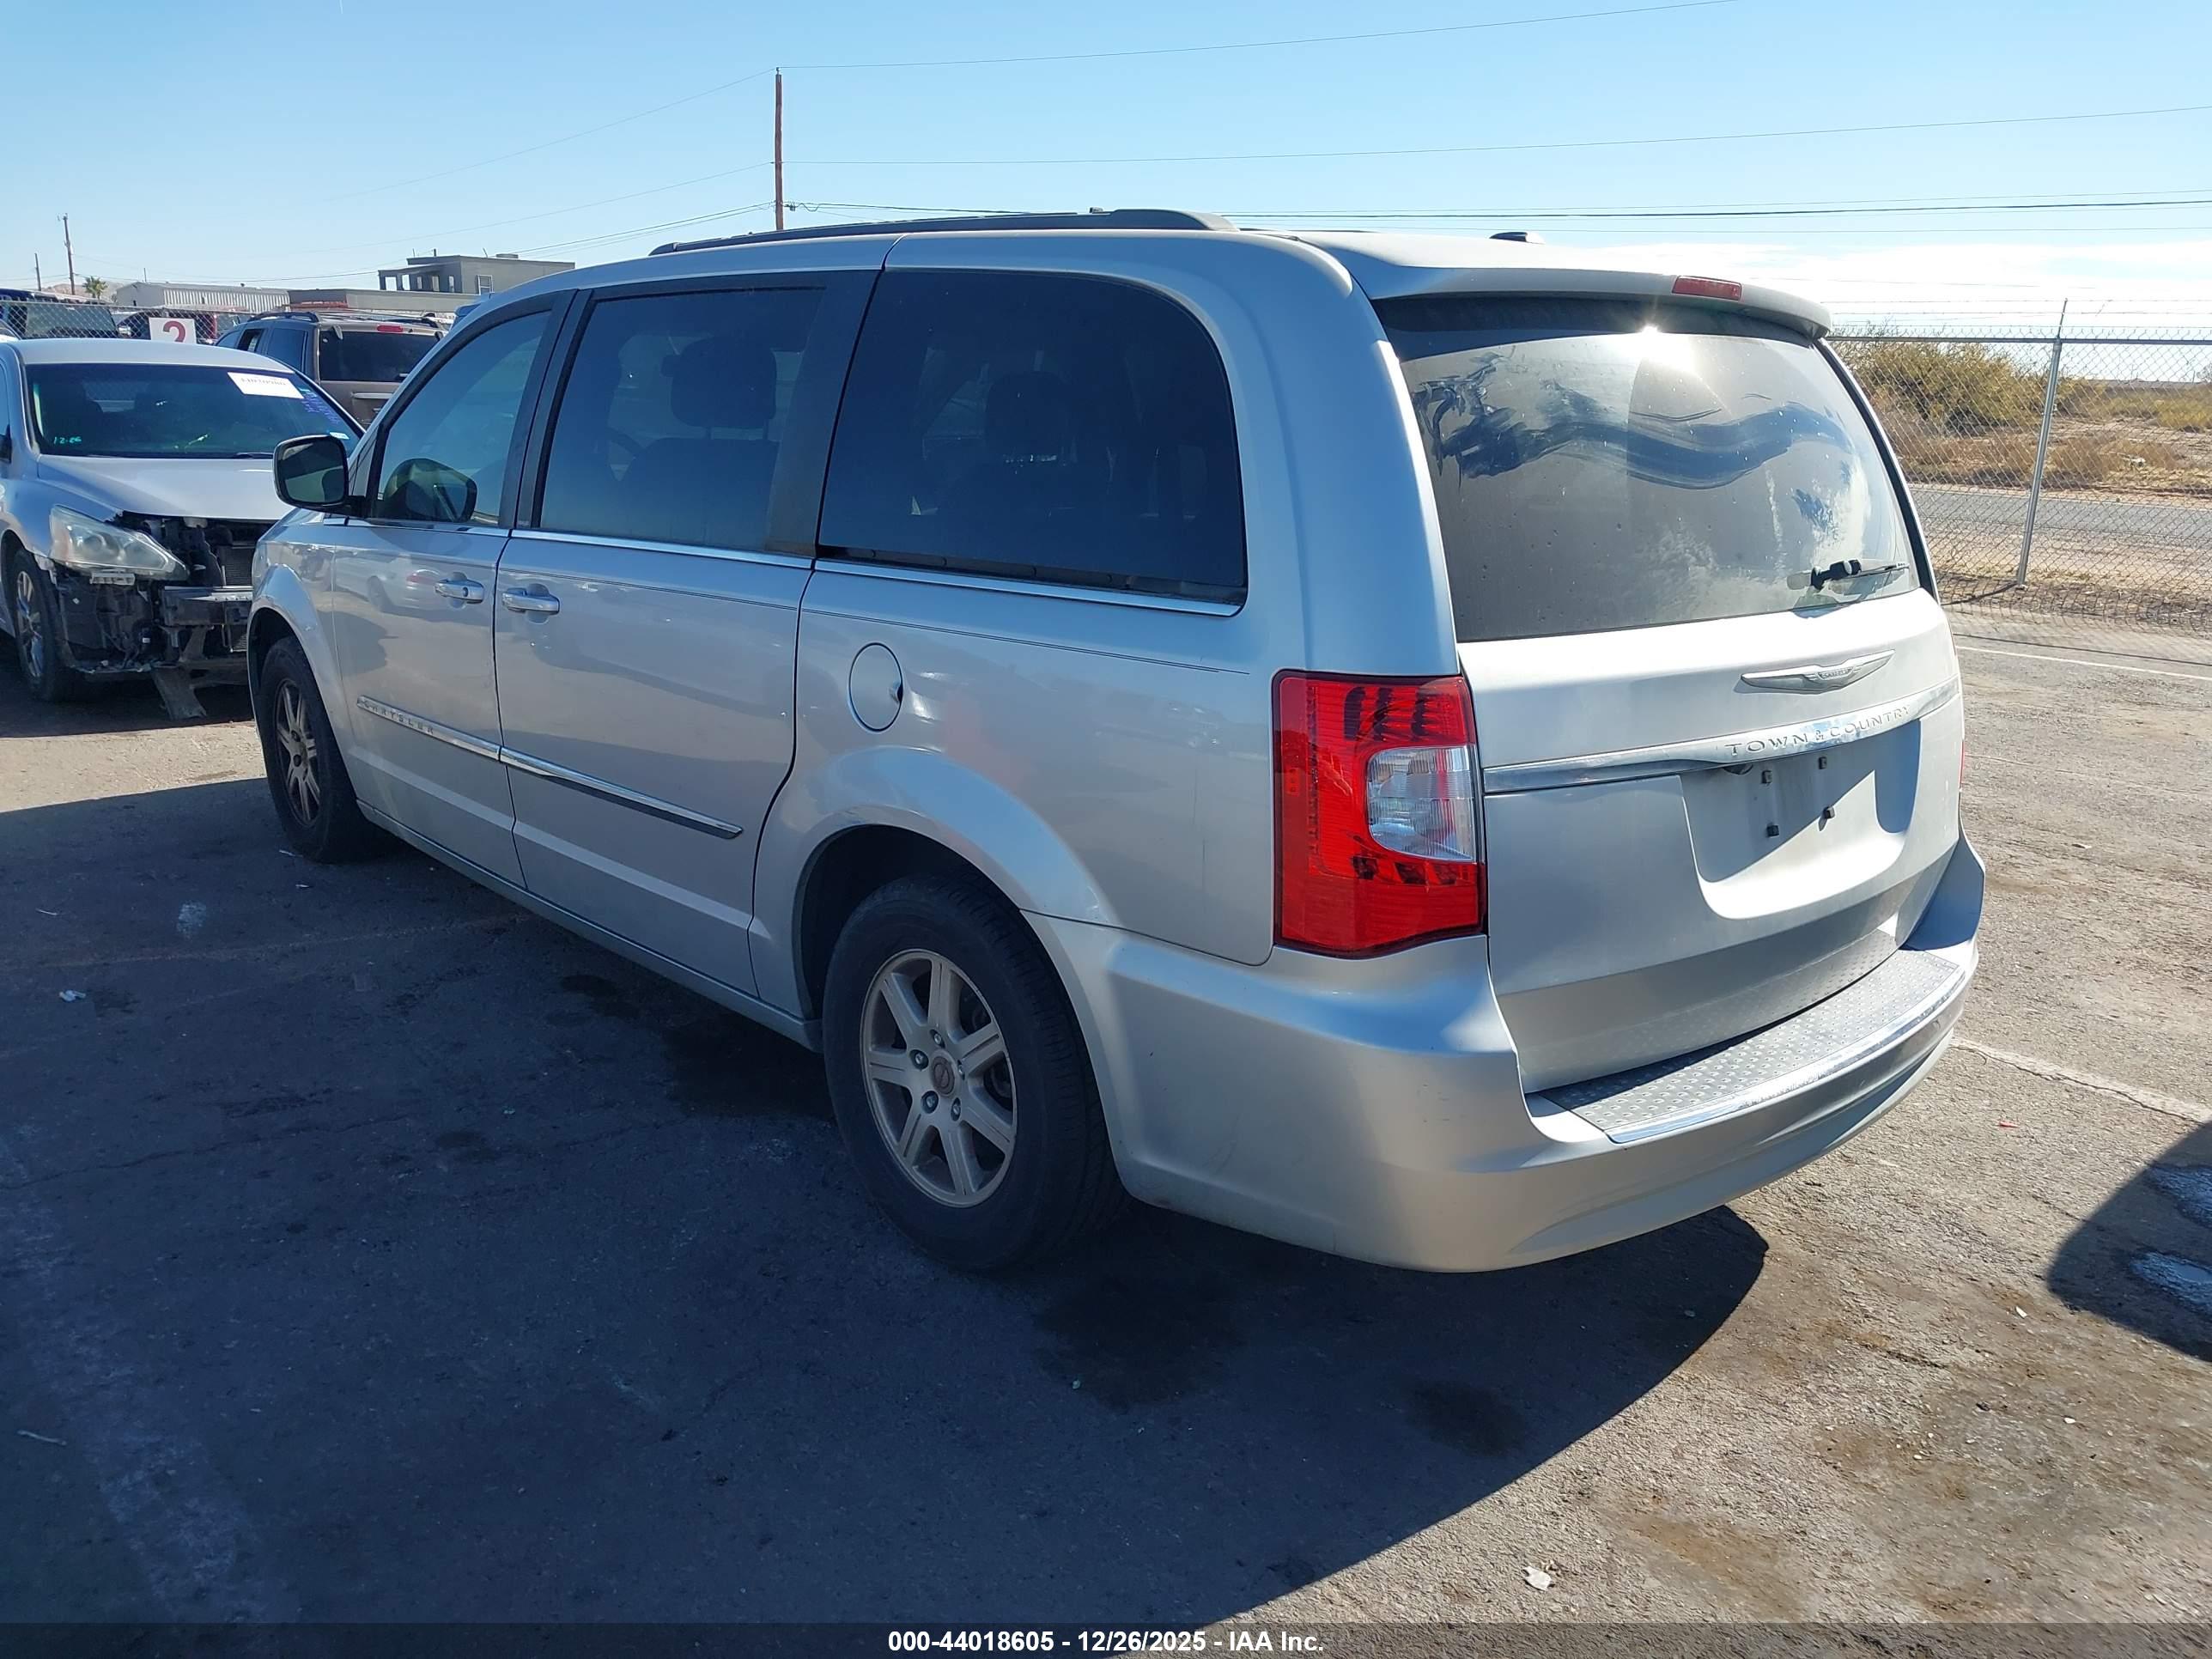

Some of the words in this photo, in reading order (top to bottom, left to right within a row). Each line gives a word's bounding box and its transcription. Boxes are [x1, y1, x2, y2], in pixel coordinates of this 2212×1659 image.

[1724, 732, 1808, 756] TOWN
[1814, 729, 1825, 741] &
[1830, 704, 1911, 738] COUNTRY
